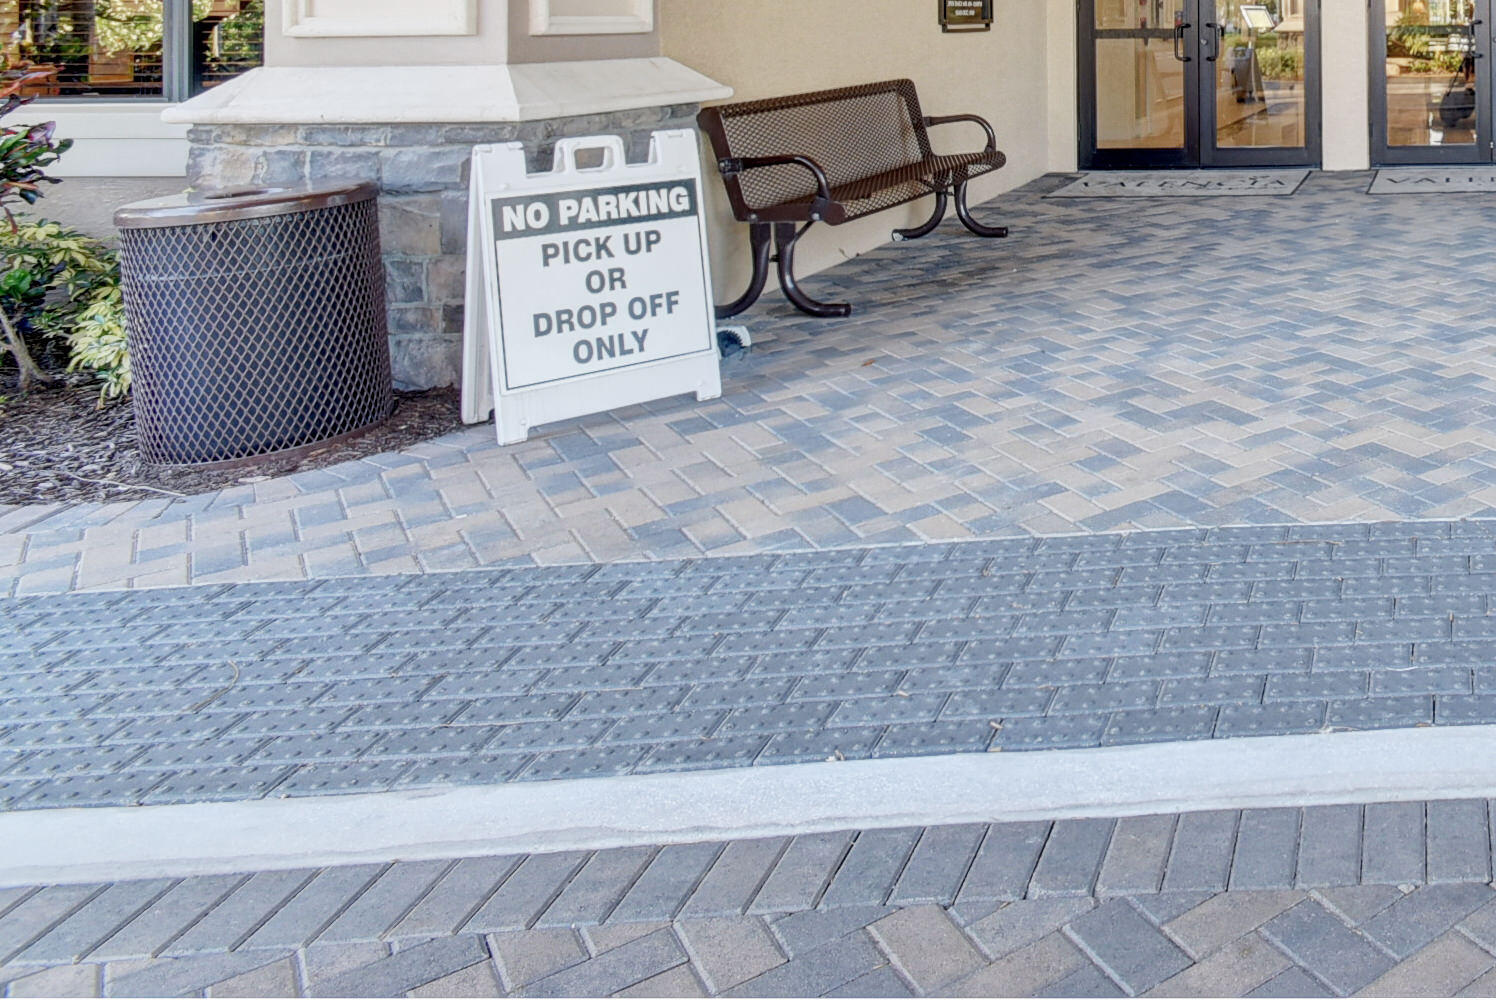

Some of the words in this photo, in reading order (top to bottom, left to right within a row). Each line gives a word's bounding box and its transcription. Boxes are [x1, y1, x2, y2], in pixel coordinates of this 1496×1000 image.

[502, 202, 550, 232] NO
[559, 186, 690, 225] PARKING
[541, 236, 614, 267] PICK
[623, 229, 662, 255] UP
[585, 267, 627, 293] OR
[533, 302, 617, 338] DROP
[628, 290, 680, 320] OFF
[573, 328, 649, 364] ONLY
